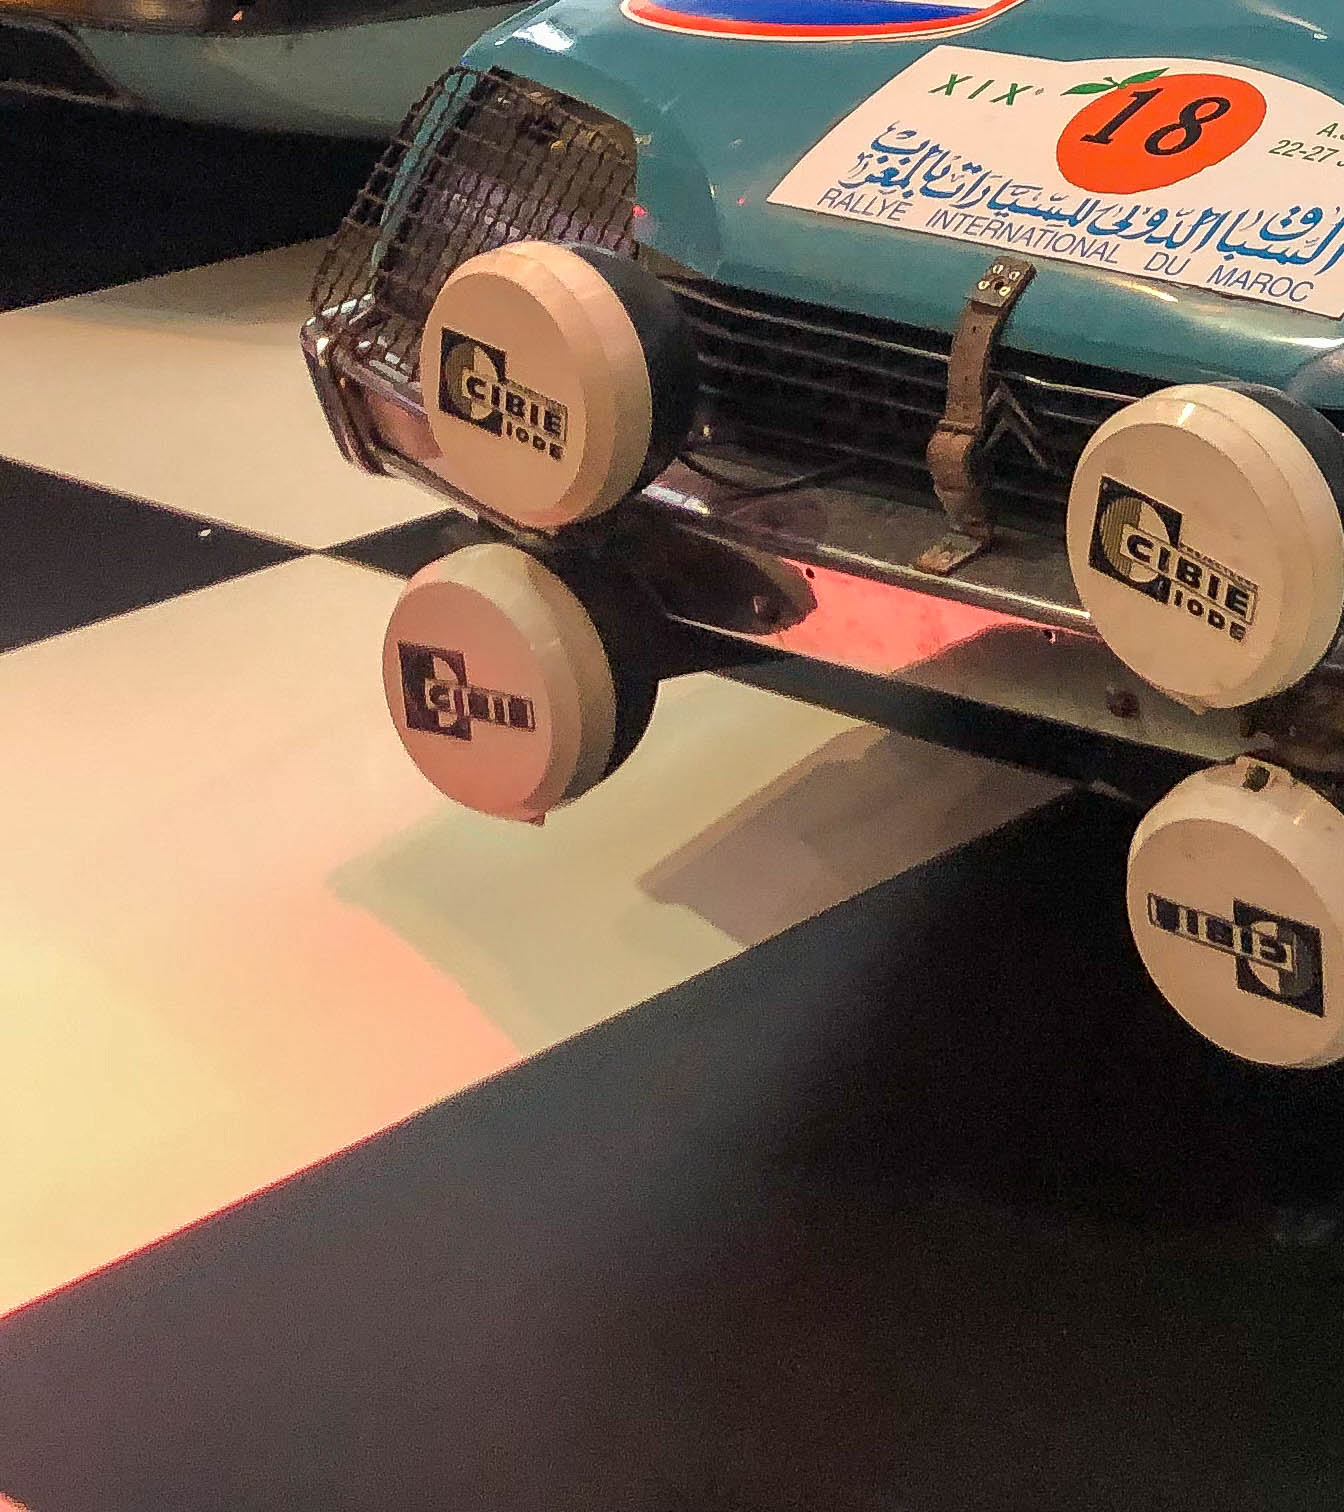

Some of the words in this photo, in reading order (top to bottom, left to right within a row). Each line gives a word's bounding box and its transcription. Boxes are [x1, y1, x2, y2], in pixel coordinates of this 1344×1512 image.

[1080, 87, 1232, 156] 18
[1268, 139, 1340, 164] 22-27
[817, 187, 913, 224] RALLYE
[925, 207, 1121, 266] INTERNATIONAL
[1143, 251, 1192, 276] DU
[1206, 263, 1315, 303] MAROC
[466, 375, 562, 440] CIBIE
[1127, 534, 1250, 619] CIBIE
